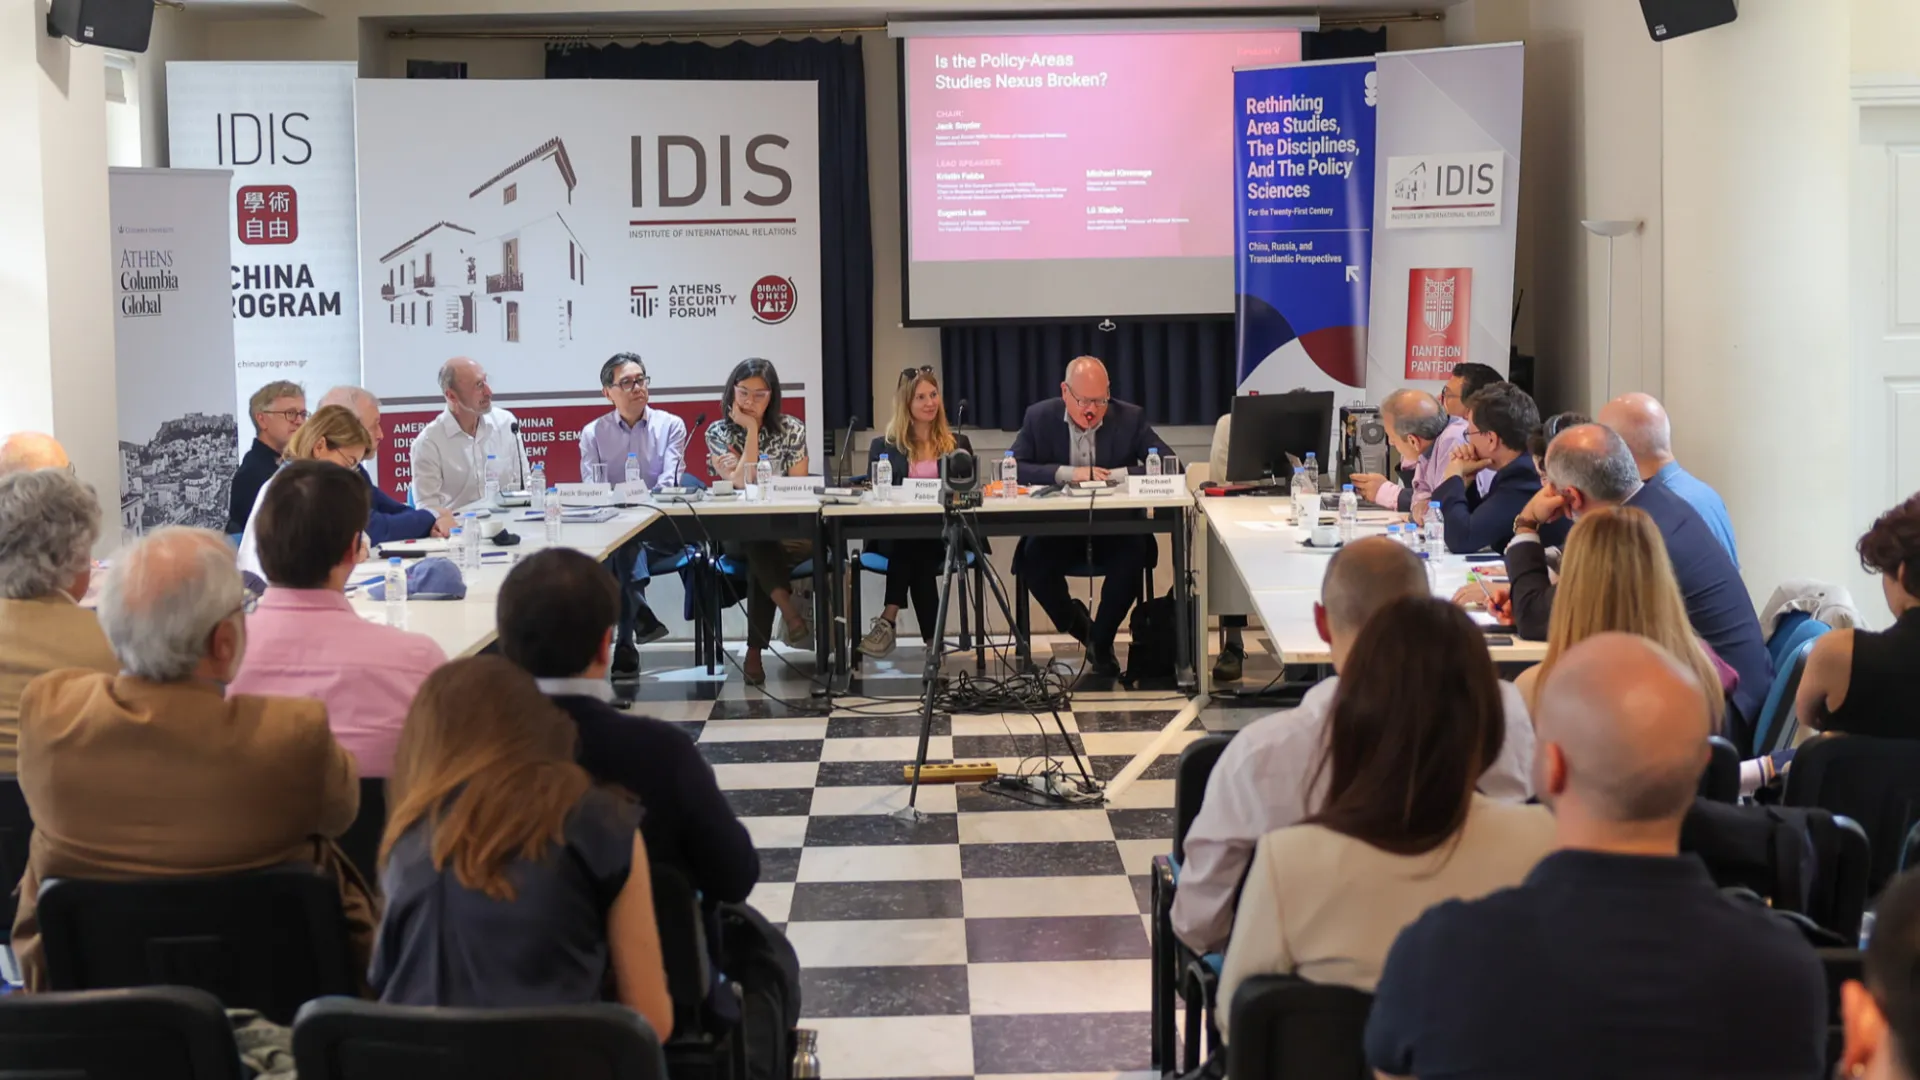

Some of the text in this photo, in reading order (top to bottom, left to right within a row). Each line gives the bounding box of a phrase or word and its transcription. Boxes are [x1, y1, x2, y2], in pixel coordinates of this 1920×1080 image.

[935, 52, 1074, 70] Is the Policy-Areas
[935, 72, 1108, 89] Studies Nexus Broken?
[1246, 94, 1324, 114] Rethinking
[1246, 115, 1340, 136] Area Studies,
[217, 112, 312, 165] IDIS
[1246, 136, 1360, 158] The Disciplines,
[631, 134, 792, 208] IDIS
[1247, 157, 1353, 179] And The Policy
[1437, 163, 1494, 196] IDIS
[1247, 181, 1311, 200] Sciences
[1248, 207, 1334, 217] For the Twenty-First Century
[629, 227, 797, 239] INSTITUTE OF INTERNATIONAL RELATIONS
[1248, 241, 1313, 252] China, Russia, and
[120, 248, 173, 268] ATHENS
[1249, 253, 1342, 265] Transatlantic Perspectives
[121, 269, 179, 290] Columbia
[669, 284, 722, 295] ATHENS
[122, 293, 162, 316] Global
[232, 291, 341, 318] OGRAM
[669, 295, 737, 307] SECURITY
[669, 307, 716, 318] FORUM
[237, 359, 308, 369] chinaprogram.gr
[519, 417, 554, 428] MINAR
[559, 431, 581, 441] SEM
[915, 481, 938, 489] Kristin
